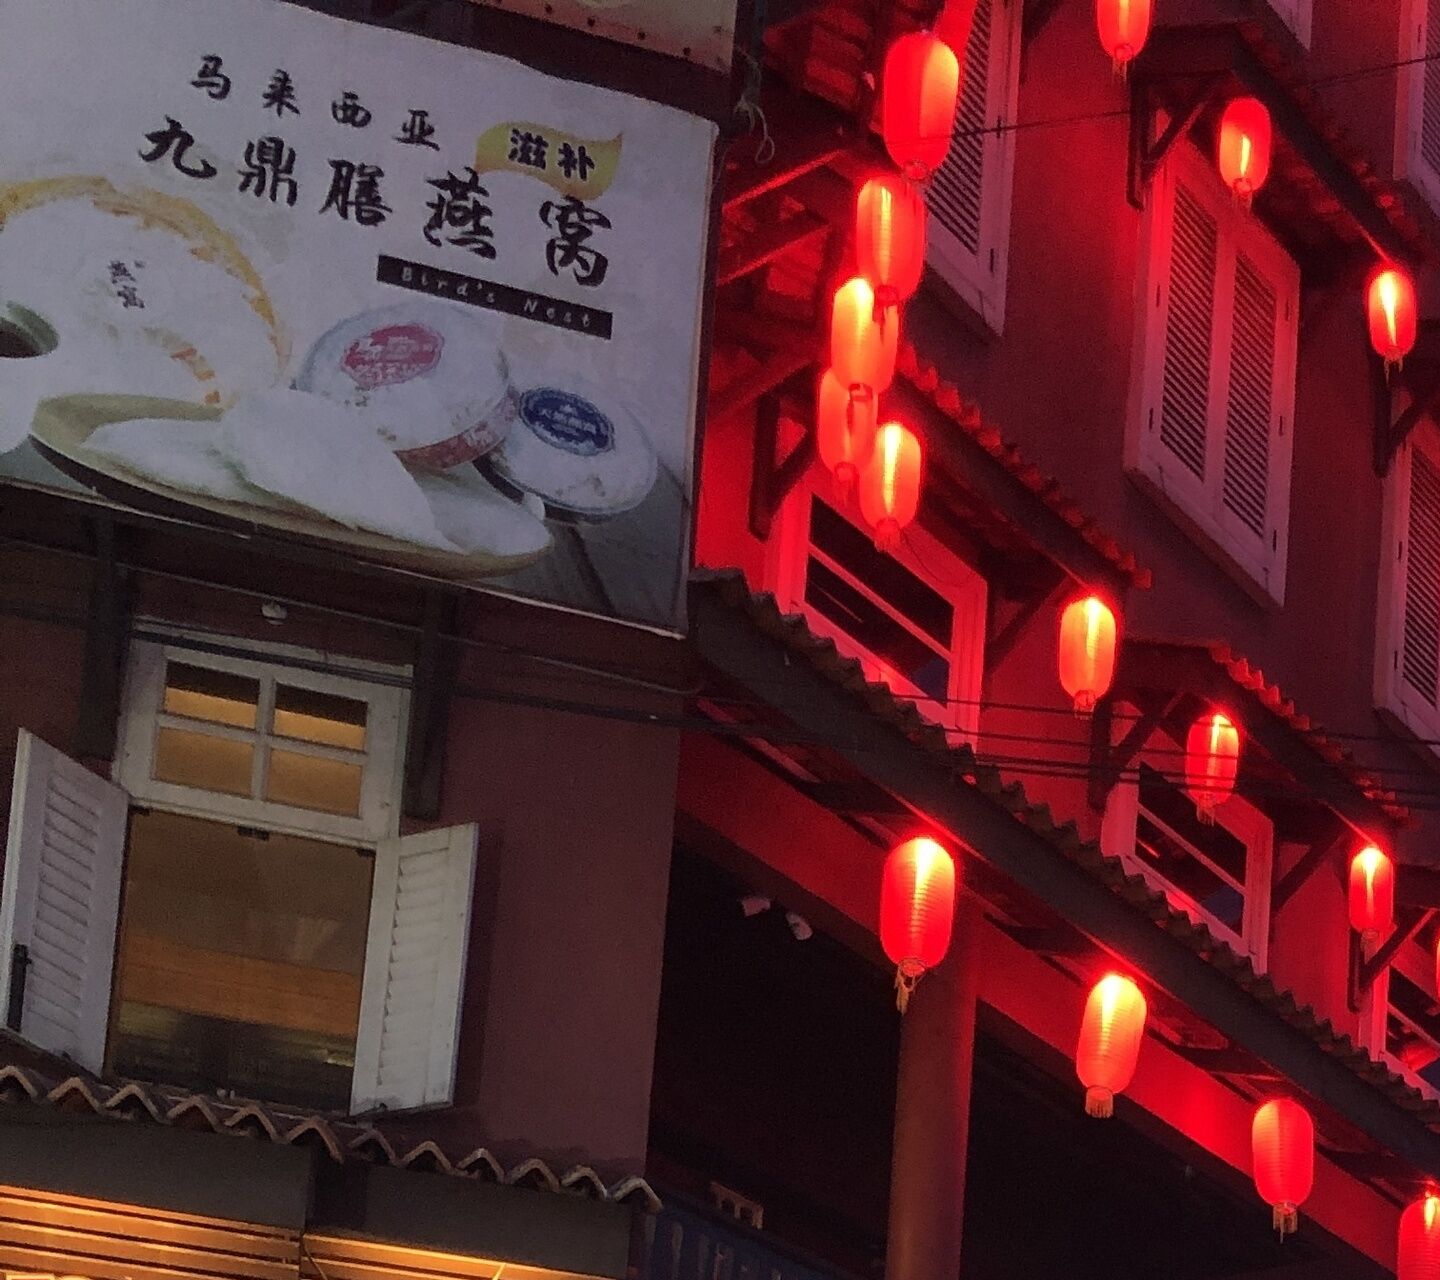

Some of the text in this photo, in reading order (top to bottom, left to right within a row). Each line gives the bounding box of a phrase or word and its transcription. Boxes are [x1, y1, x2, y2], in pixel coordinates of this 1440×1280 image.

[190, 54, 440, 150] 马来西亚
[507, 128, 596, 183] 滋补
[401, 267, 591, 327] Bird's Nest
